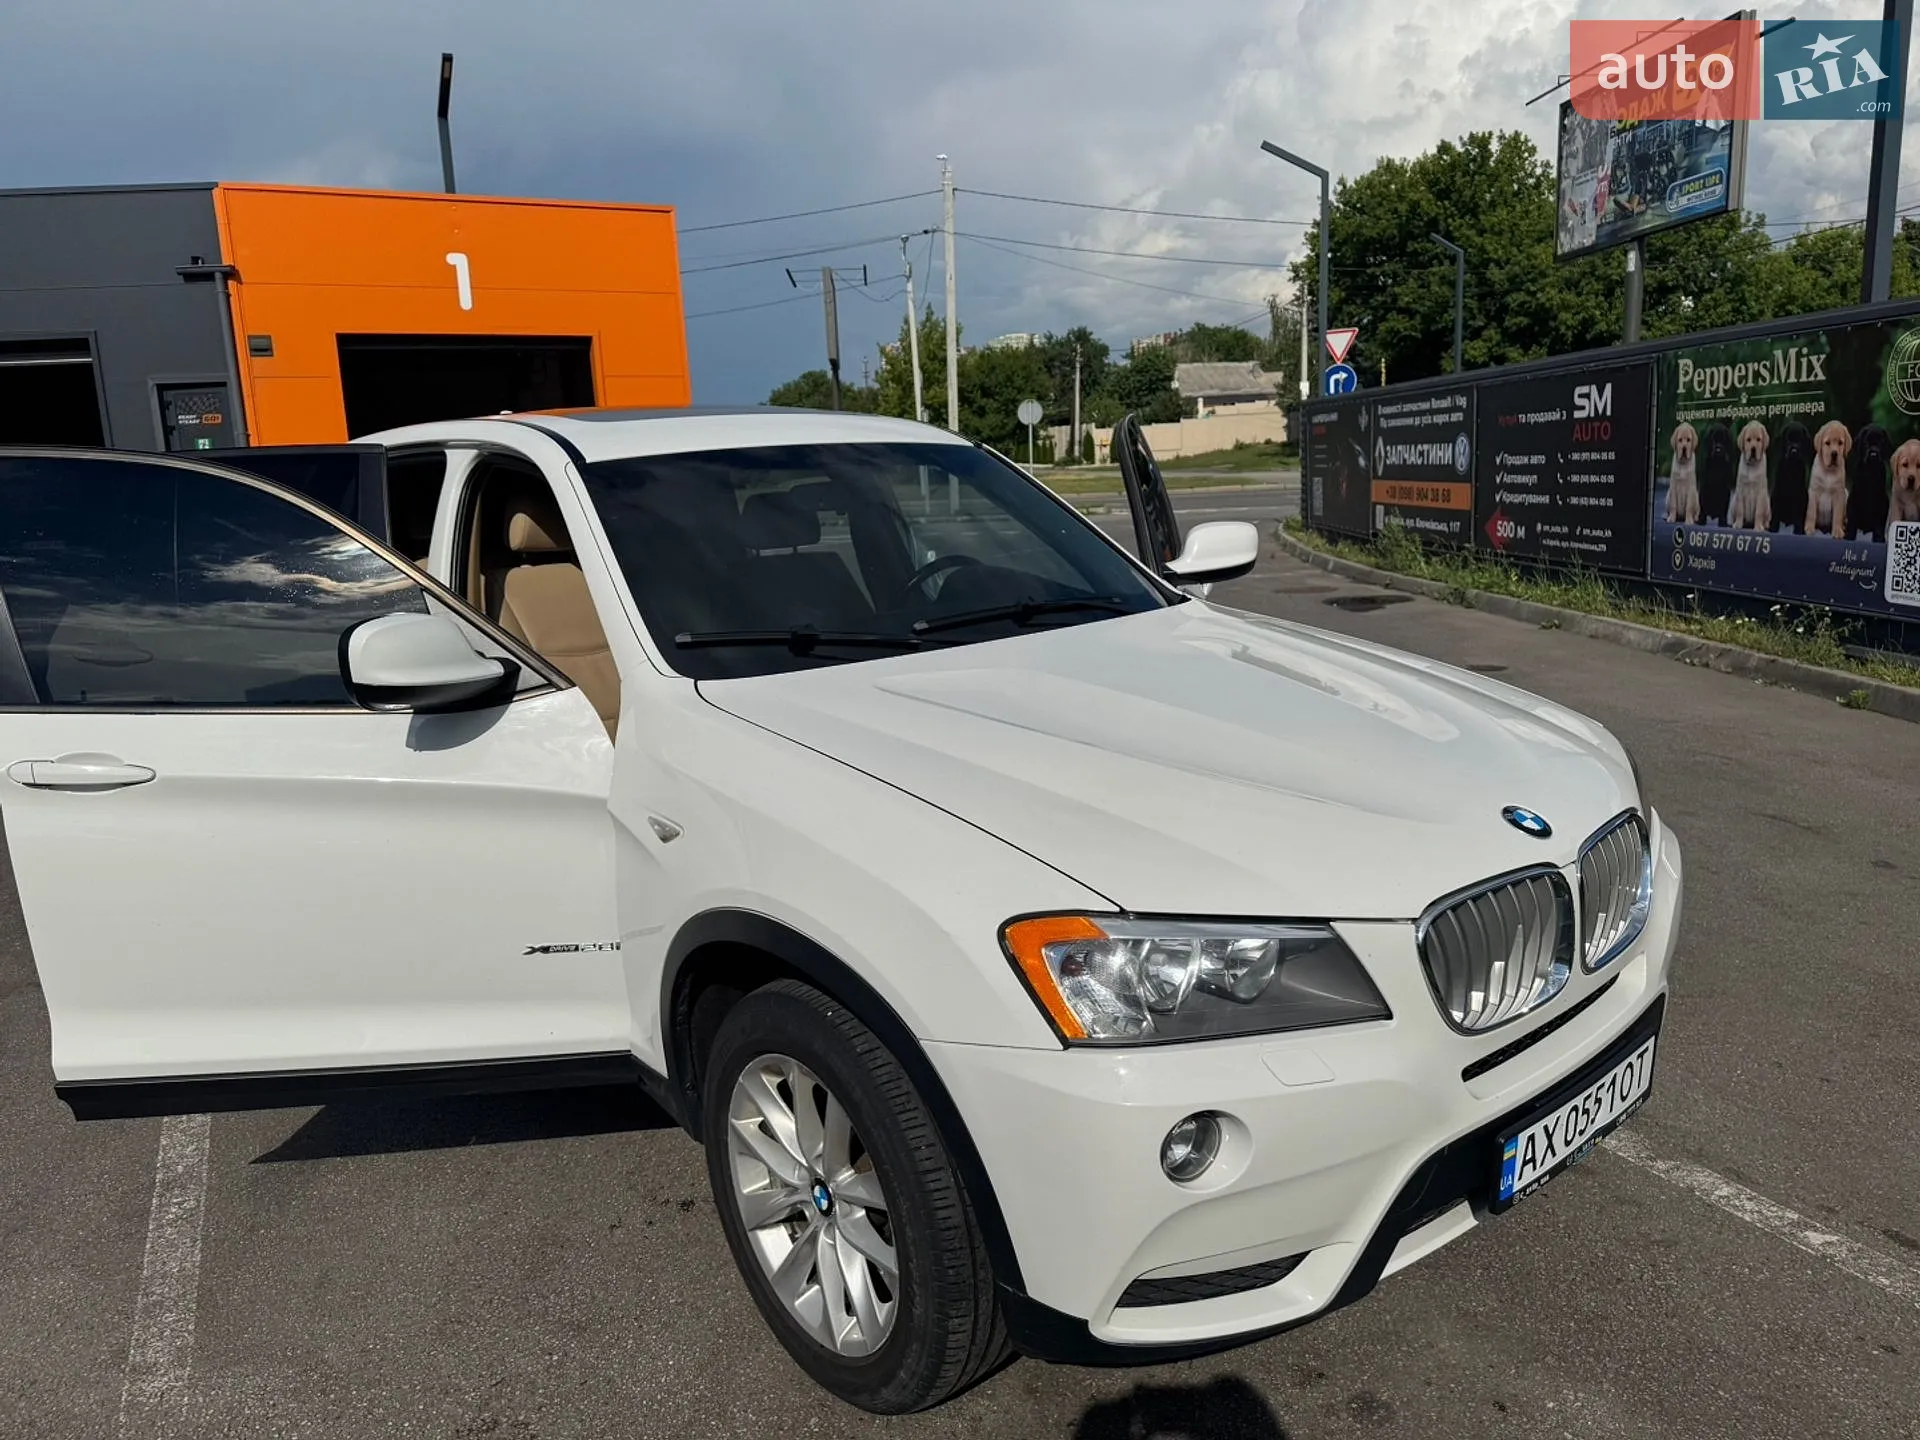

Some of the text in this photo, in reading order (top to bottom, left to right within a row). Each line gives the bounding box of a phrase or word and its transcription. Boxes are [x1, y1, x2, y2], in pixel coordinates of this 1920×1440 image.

[446, 252, 472, 310] 1
[1676, 347, 1827, 398] PeppersMix
[1573, 382, 1613, 419] SM
[1526, 408, 1560, 425] продавай
[1676, 401, 1825, 423] цуценята лабрадора ретривера
[1572, 421, 1612, 441] AUTO
[1386, 443, 1453, 465] ЗАПЧАСТИНИ
[1530, 454, 1546, 465] авто
[1496, 521, 1515, 539] 500
[1689, 531, 1771, 554] 067 577 67 75
[1688, 555, 1716, 570] Харків
[1500, 1173, 1513, 1192] UA
